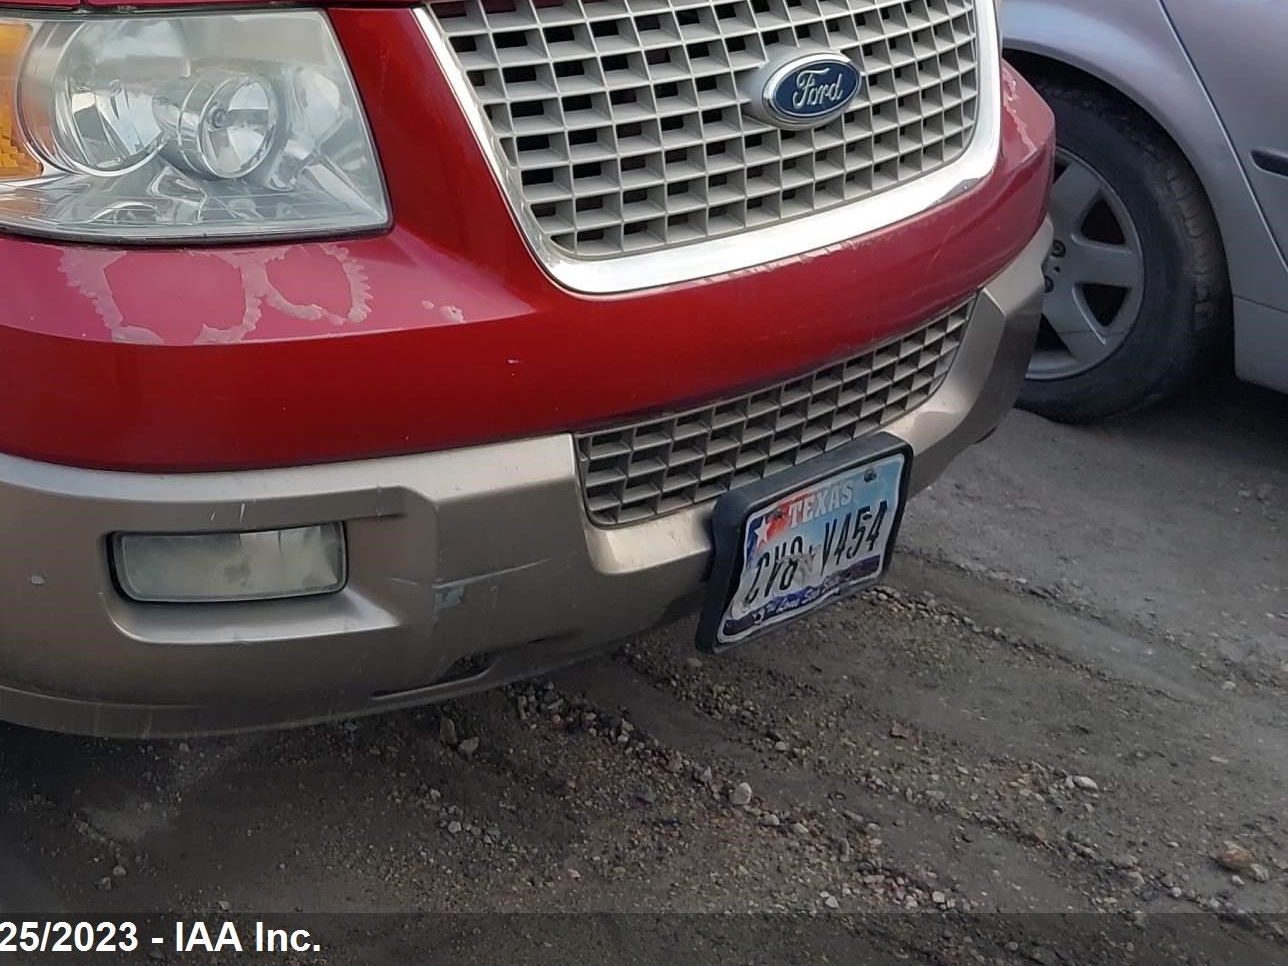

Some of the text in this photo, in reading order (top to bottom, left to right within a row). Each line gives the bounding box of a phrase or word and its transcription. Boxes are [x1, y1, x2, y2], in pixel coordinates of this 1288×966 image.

[792, 67, 843, 110] Ford
[788, 480, 854, 528] TEXAS
[821, 500, 889, 577] V454
